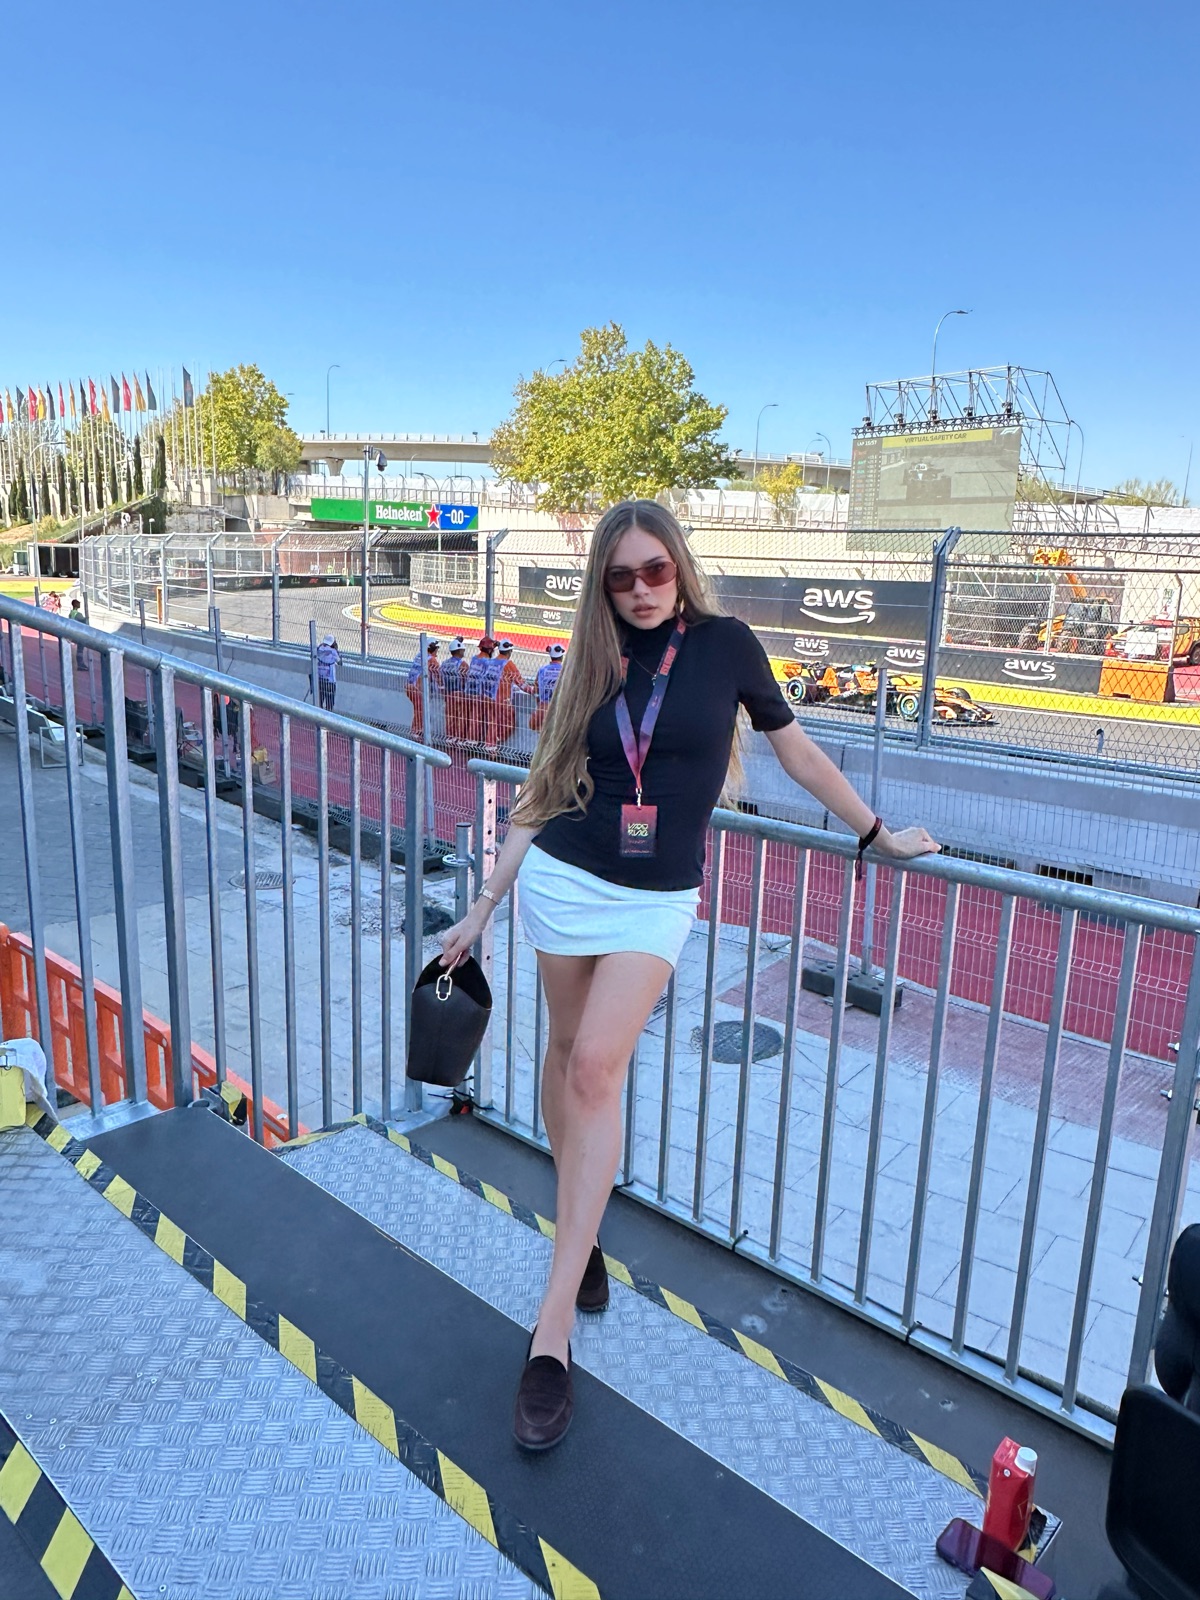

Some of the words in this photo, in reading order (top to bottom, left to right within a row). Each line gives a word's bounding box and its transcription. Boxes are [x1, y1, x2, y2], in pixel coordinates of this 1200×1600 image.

[904, 435, 930, 443] VIRTUAL
[930, 433, 953, 442] SAFETY
[954, 432, 967, 440] CAR
[375, 504, 423, 522] Heineken
[545, 574, 583, 591] aws
[803, 587, 874, 610] aws
[542, 611, 561, 621] aws
[794, 637, 829, 650] aws
[886, 646, 926, 660] aws
[1004, 657, 1056, 673] aws
